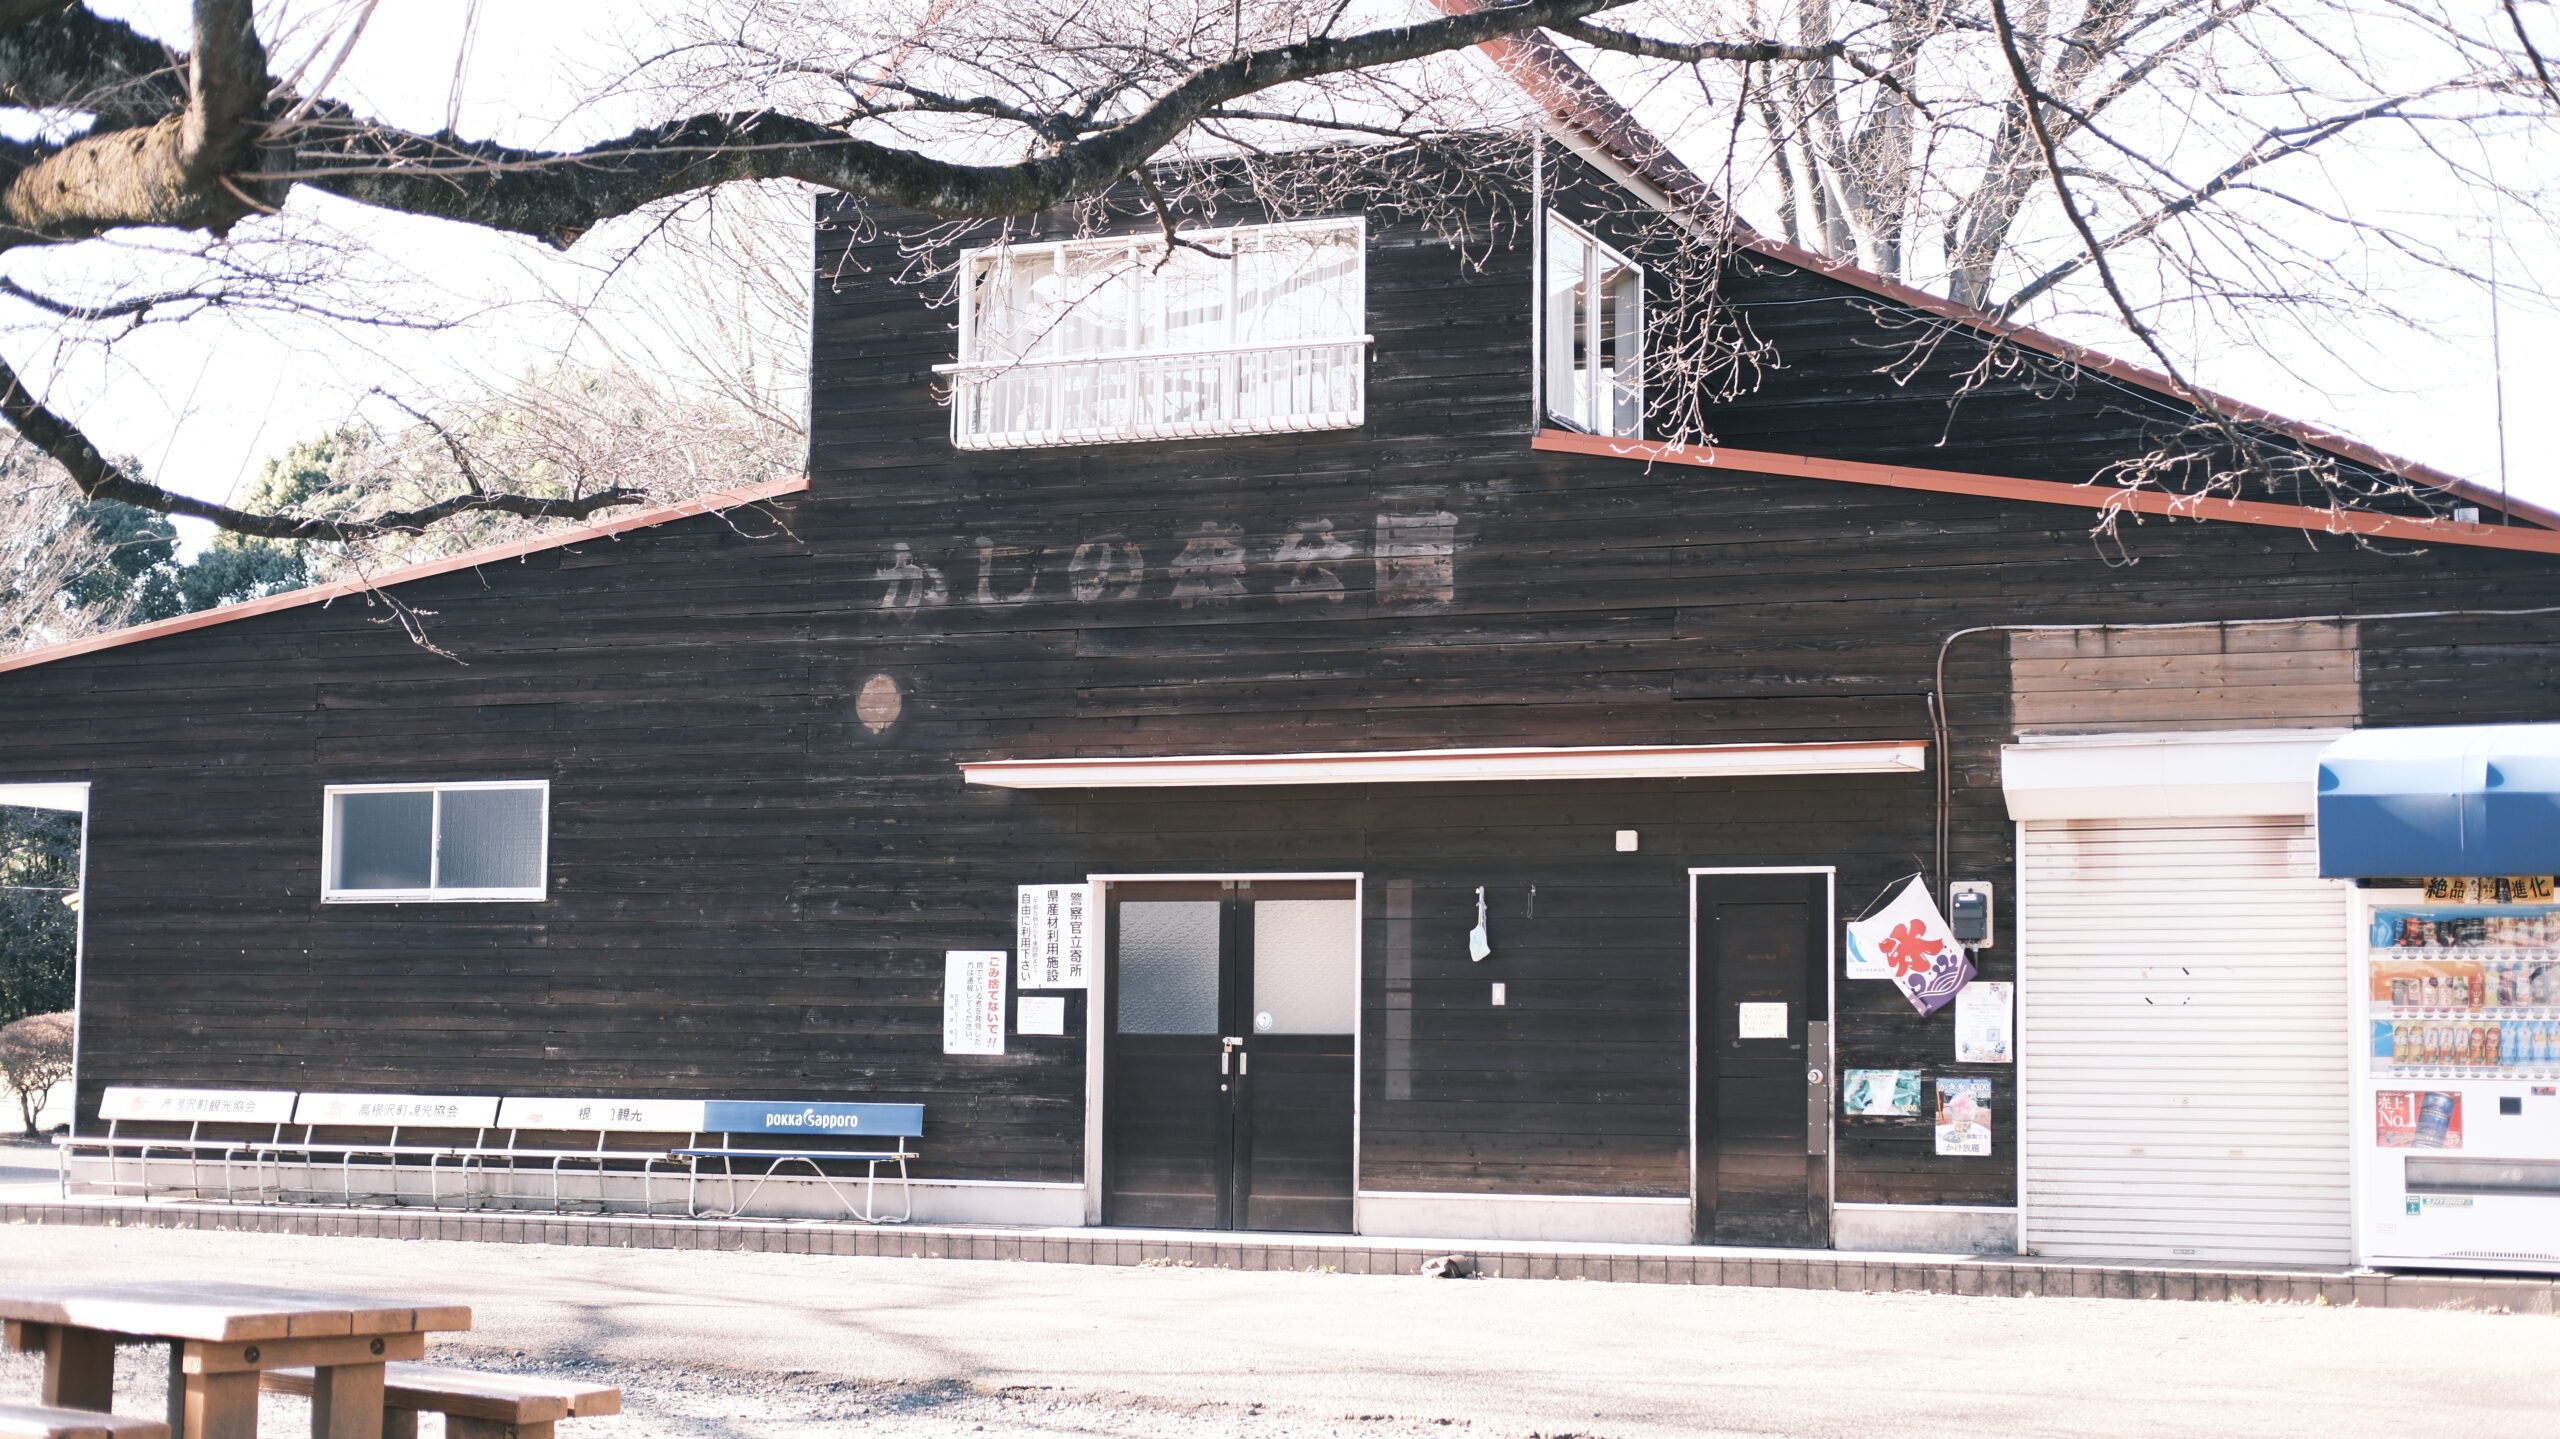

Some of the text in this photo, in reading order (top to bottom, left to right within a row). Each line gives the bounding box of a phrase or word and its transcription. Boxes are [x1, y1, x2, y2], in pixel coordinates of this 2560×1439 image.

[2511, 877, 2551, 899] 進化
[1020, 893, 1032, 982] 自由に利用下さい
[1046, 889, 1059, 982] 県産材利用施設
[1069, 892, 1083, 977] 警察官立寄所
[1878, 918, 1944, 978] 氷
[2378, 1096, 2404, 1109] 売上
